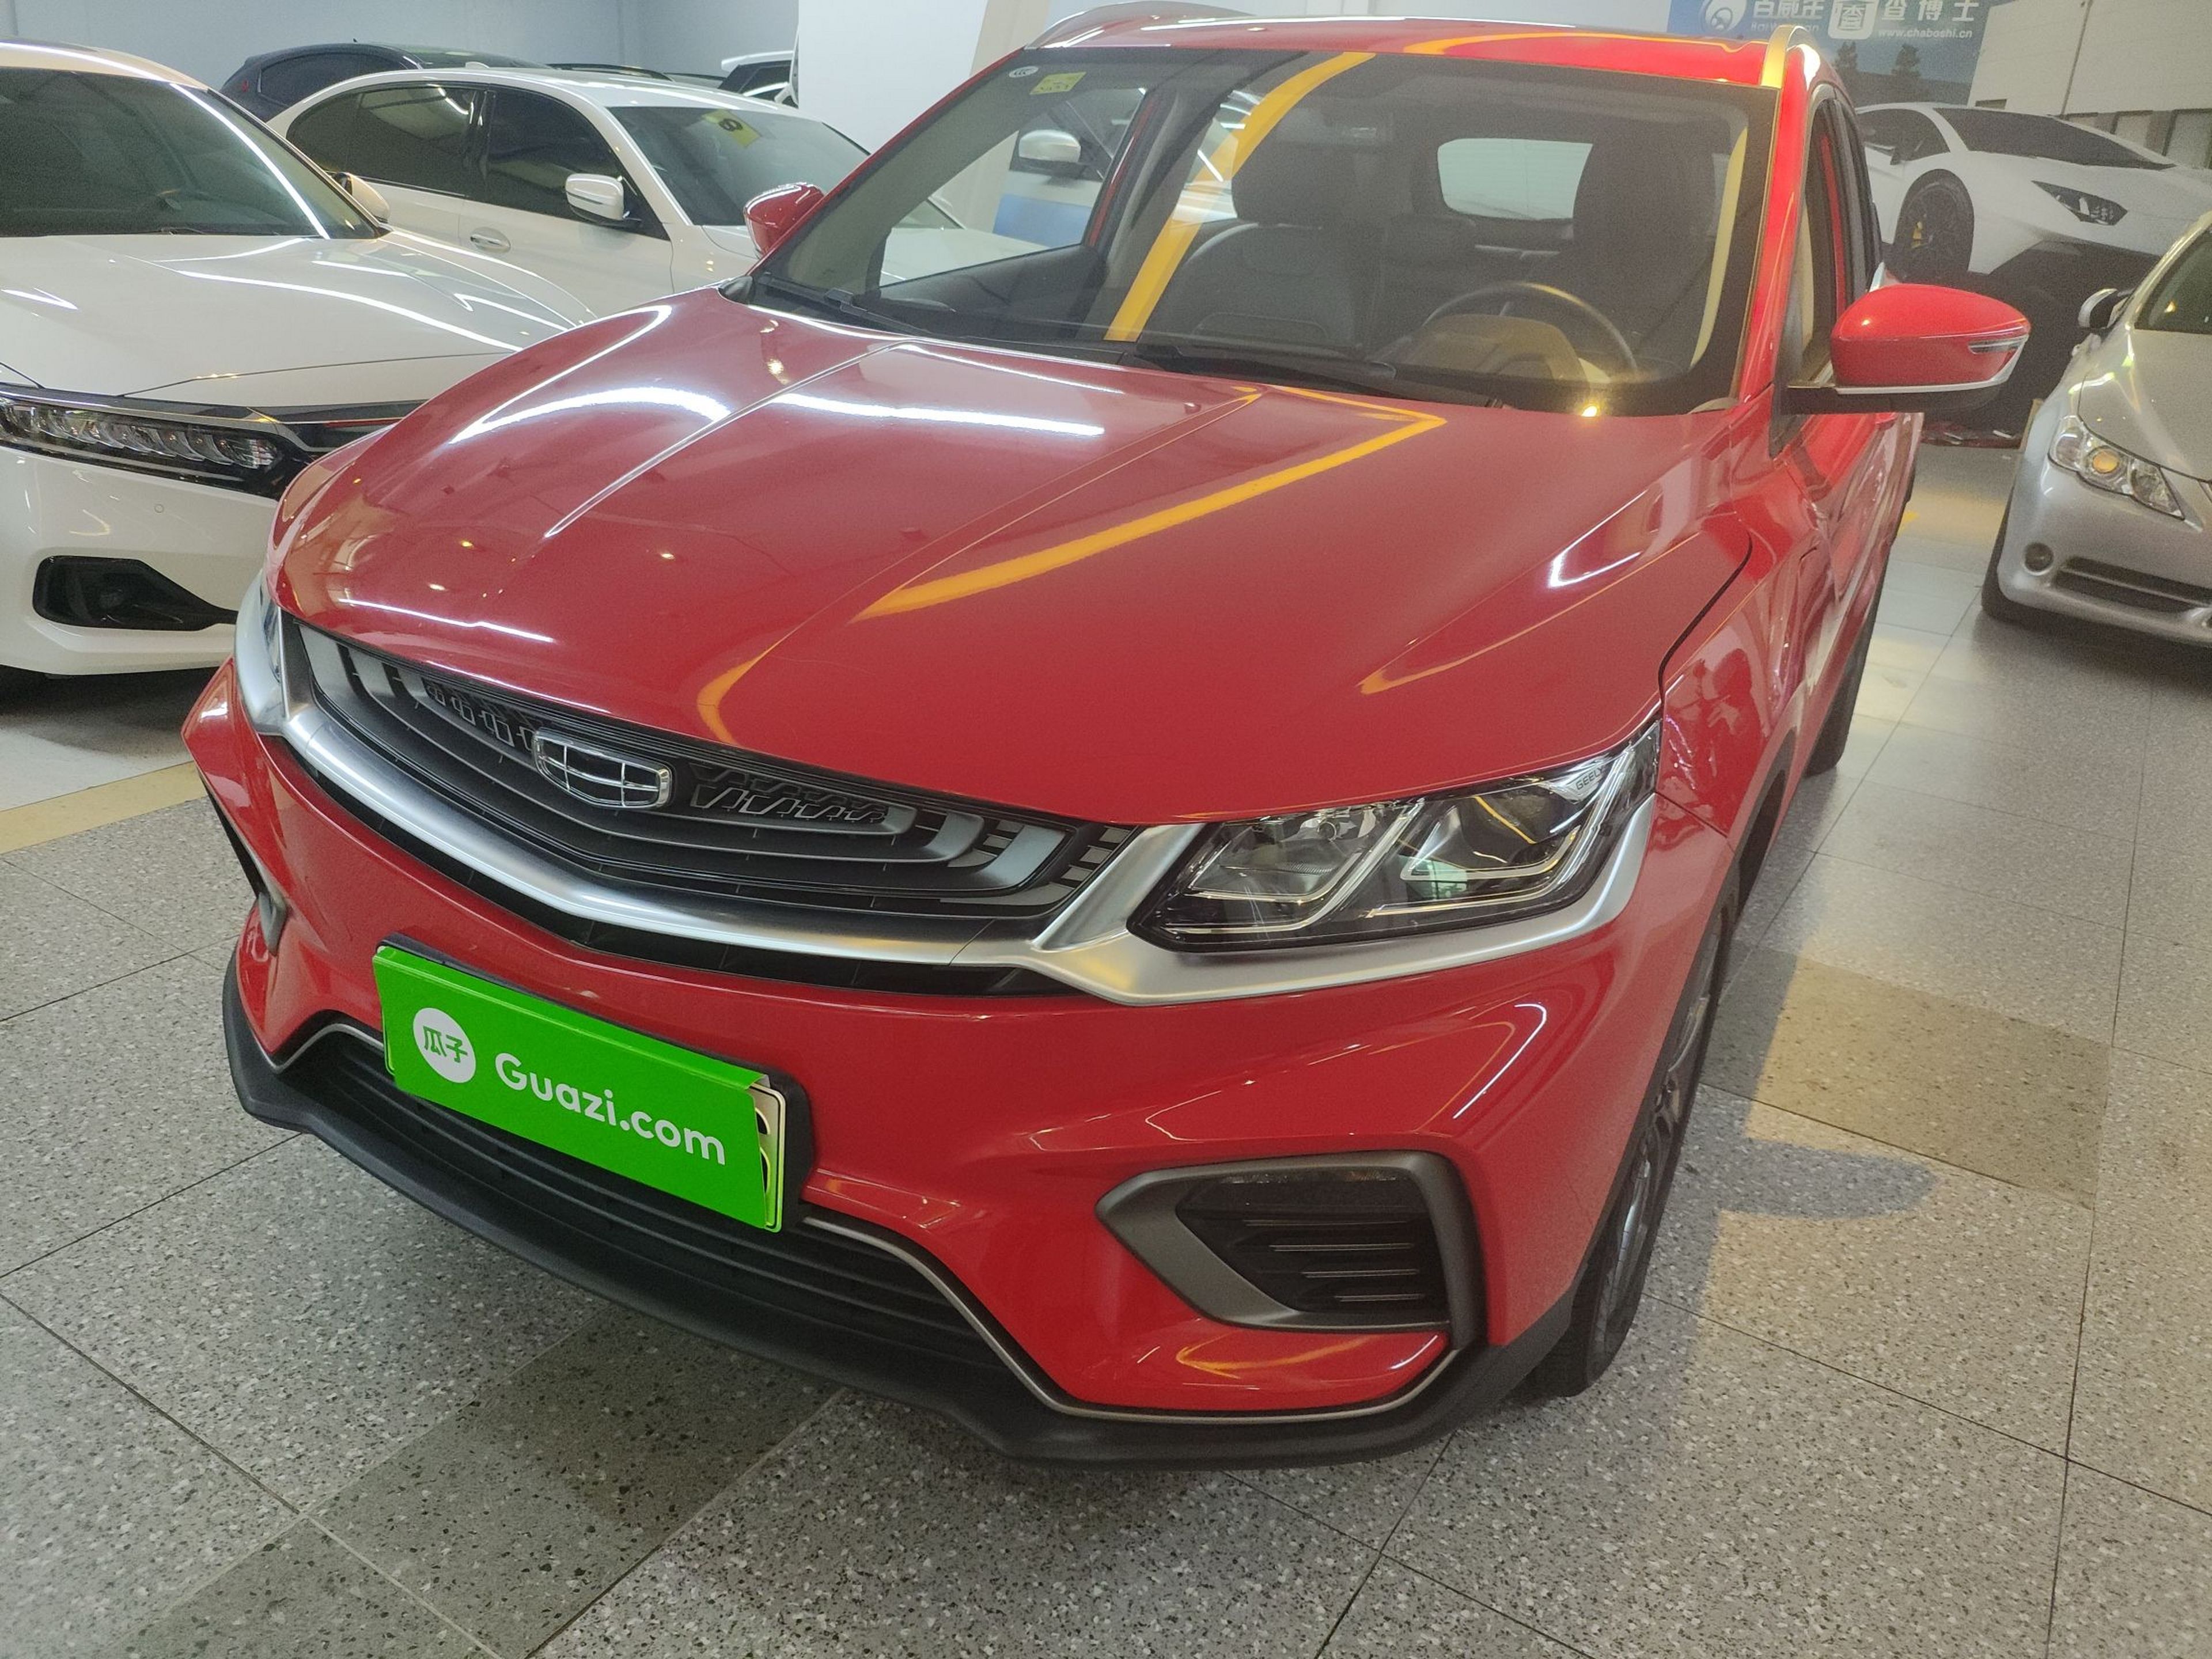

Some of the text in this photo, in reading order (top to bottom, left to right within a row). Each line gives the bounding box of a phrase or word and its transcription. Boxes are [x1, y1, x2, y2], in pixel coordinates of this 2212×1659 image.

[1881, 0, 1980, 22] 查博士
[1878, 28, 1973, 39] www.chaboshi.cn
[1575, 766, 1604, 790] GEELY
[422, 1025, 468, 1063] 瓜子
[495, 1052, 726, 1166] Guazi.com
